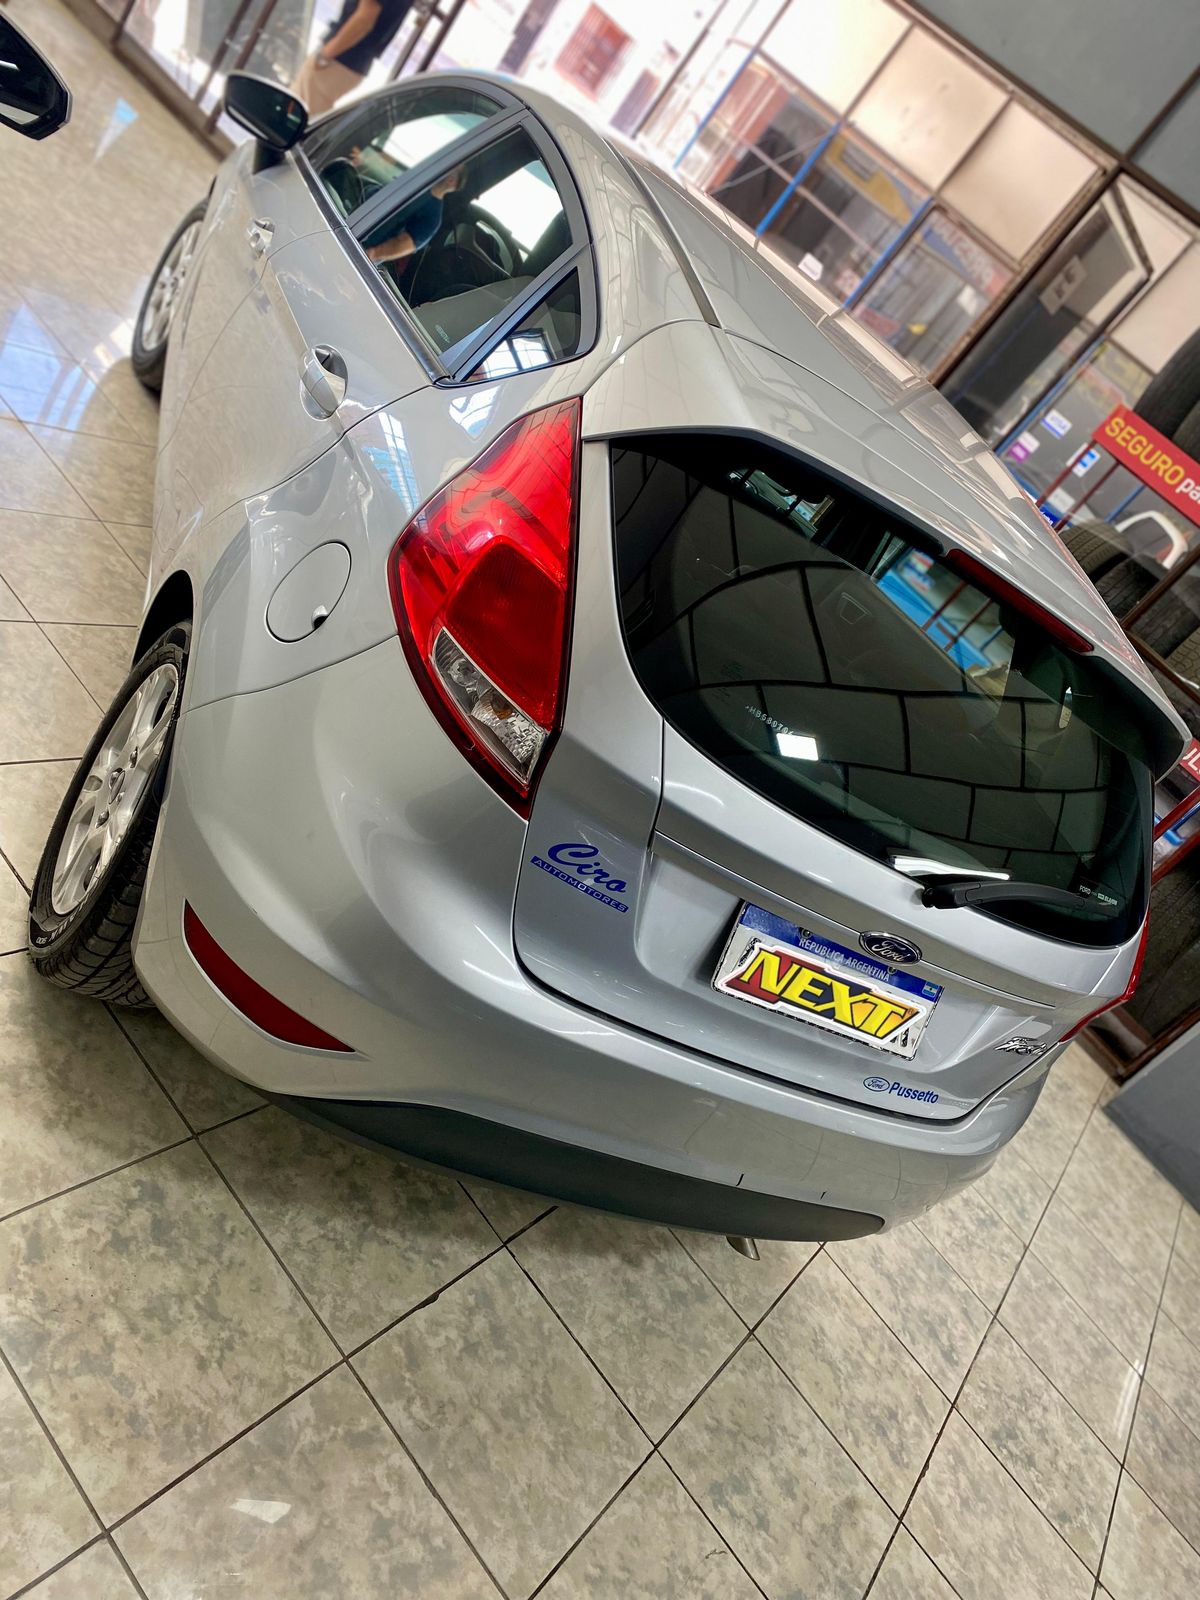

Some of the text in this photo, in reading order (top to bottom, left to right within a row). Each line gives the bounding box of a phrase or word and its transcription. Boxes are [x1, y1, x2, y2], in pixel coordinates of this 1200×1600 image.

[1105, 416, 1185, 485] SEGURO
[533, 859, 626, 912] AUTOMOTORES
[547, 843, 627, 893] Ciro
[798, 937, 891, 982] REPUBLICA ARGENTINA
[870, 939, 910, 962] Ford
[739, 949, 907, 1039] NEXT
[867, 1078, 939, 1104] Ford Pussetto
